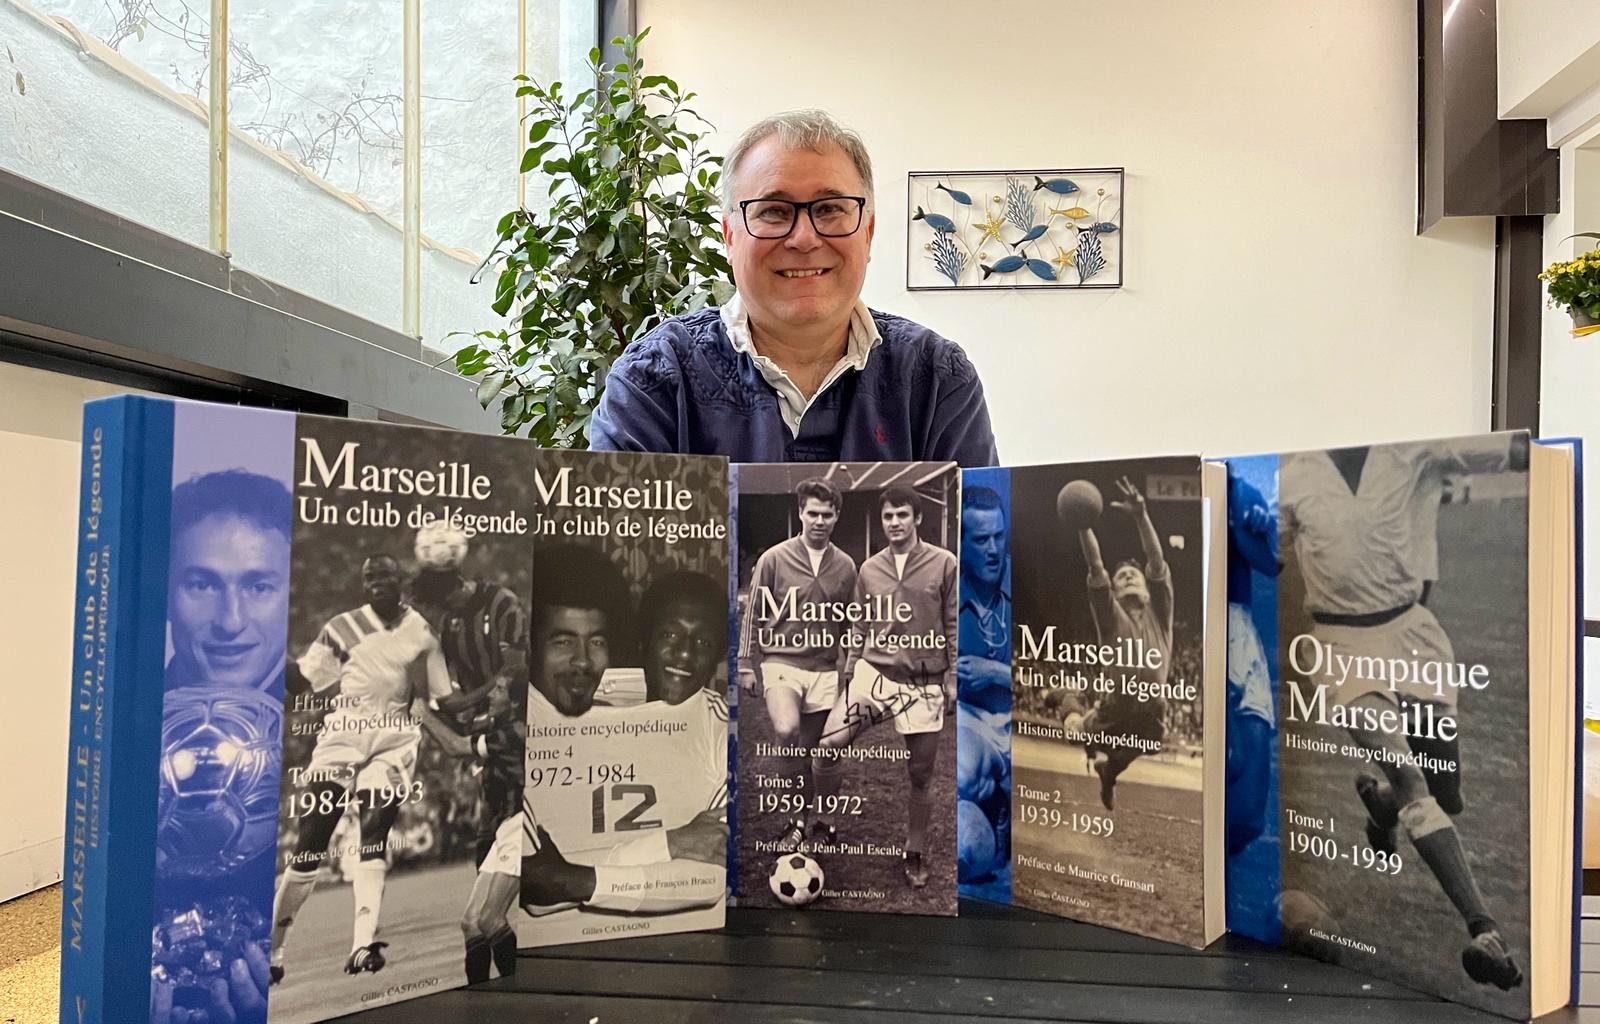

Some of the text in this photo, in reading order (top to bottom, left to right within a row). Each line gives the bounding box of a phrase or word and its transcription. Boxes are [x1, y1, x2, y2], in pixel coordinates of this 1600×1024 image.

[87, 426, 103, 540] légende
[298, 437, 492, 500] Marseille
[534, 466, 693, 511] Marseille
[298, 496, 528, 538] Un club de légende
[563, 513, 610, 536] club
[616, 516, 642, 537] de
[648, 516, 727, 544] légende
[85, 552, 98, 586] de
[757, 585, 913, 623] Marseille
[83, 595, 96, 660] club
[757, 627, 947, 654] Un club de légende
[1018, 624, 1163, 669] Marseille
[1288, 634, 1491, 696] Olympique
[80, 670, 92, 711] Un
[1018, 666, 1197, 702] Un club de légende
[291, 693, 361, 713] Histoire
[1286, 680, 1458, 742] Marseille
[291, 712, 424, 737] encyclopédique
[580, 719, 688, 738] encyclopédique
[1018, 721, 1162, 753] Histoire encyclopédique
[526, 745, 574, 761] ome 4
[756, 743, 911, 761] Histoire encyclopédique
[1286, 733, 1457, 774] Histoire encyclopédique
[288, 763, 356, 785] Tome 5
[530, 763, 636, 789] 972-1984
[755, 775, 805, 789] Tome 3
[287, 780, 424, 819] 1984-1993
[592, 784, 663, 834] 12
[758, 794, 862, 815] 1959-1972
[1017, 785, 1061, 803] Tome 2
[1019, 804, 1115, 838] 1939-1959
[1286, 808, 1335, 832] Tome 1
[70, 745, 89, 951] MARSEILLE
[285, 850, 328, 866] Préface
[330, 846, 348, 860] de
[755, 841, 902, 856] Préface de Jean-Paul Escale
[1288, 831, 1402, 876] 1900-1939
[611, 876, 716, 893] Préface de François Bracci
[1017, 854, 1155, 893] Préface de Maurice Gransart
[842, 890, 885, 899] CASTAGNO
[1051, 891, 1090, 908] CASTAGNO
[582, 922, 650, 936] Gilles CASTAGNO
[1309, 927, 1377, 954] Gilles CASTAGNO
[361, 977, 439, 1002] Gilles CASTAGNO
